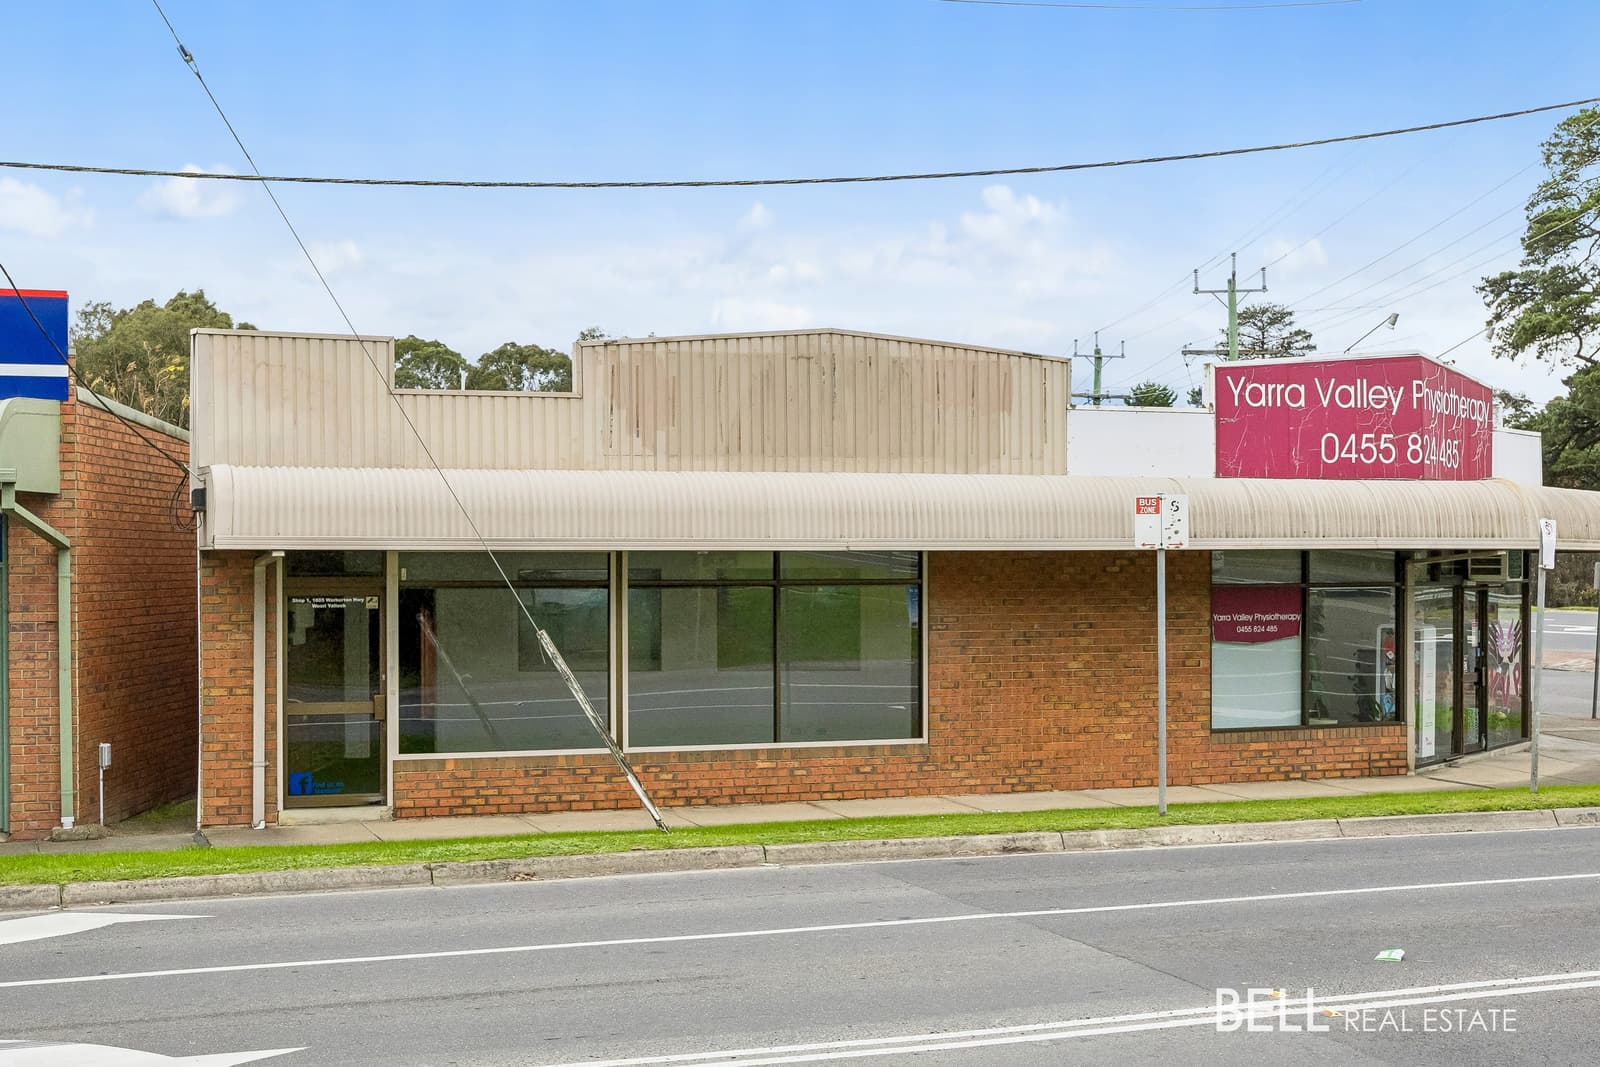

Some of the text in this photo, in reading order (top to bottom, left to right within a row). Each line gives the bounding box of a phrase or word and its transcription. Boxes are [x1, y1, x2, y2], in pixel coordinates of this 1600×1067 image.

[1226, 375, 1490, 429] Yarra Valley Physiotherapy
[1320, 432, 1459, 469] 0455 824 485
[1139, 498, 1157, 506] BUS
[1213, 613, 1302, 623] Yarra Valley Physiotherapy
[1236, 625, 1278, 633] 0455 824 485
